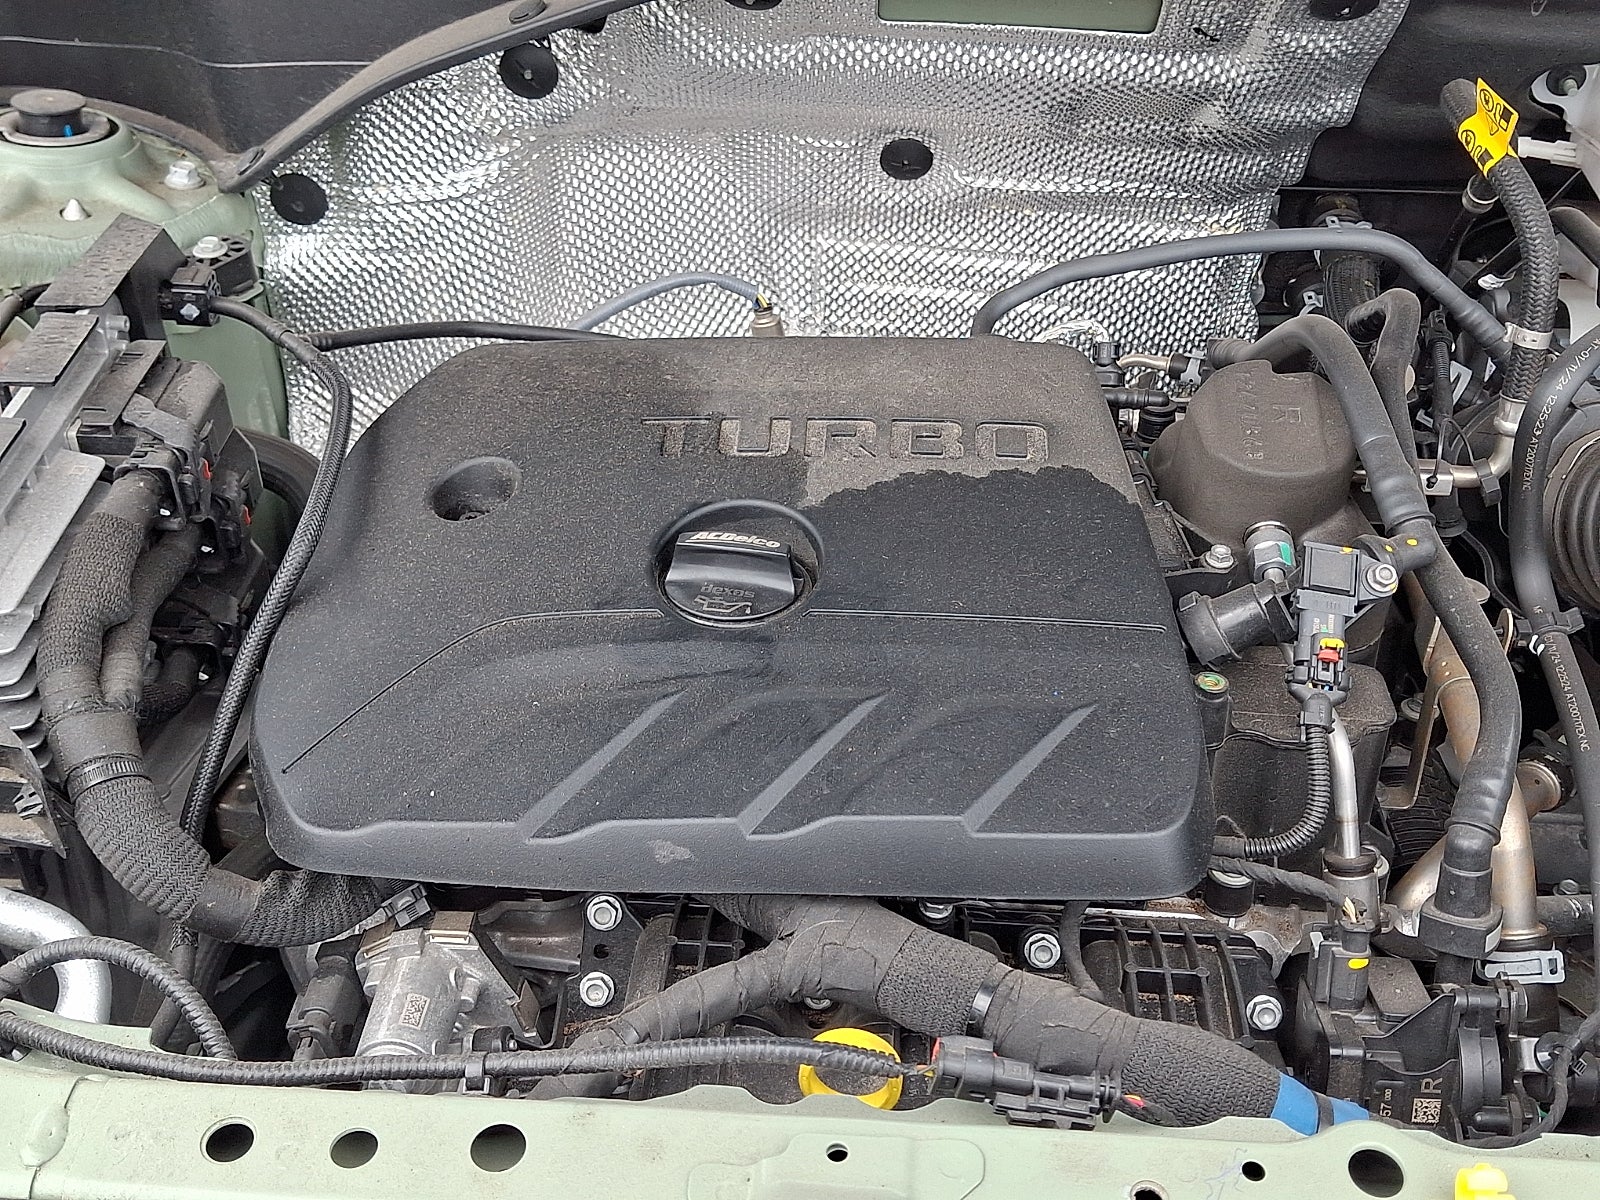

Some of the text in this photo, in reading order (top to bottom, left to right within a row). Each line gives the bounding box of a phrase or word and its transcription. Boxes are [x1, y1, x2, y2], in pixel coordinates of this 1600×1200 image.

[641, 416, 1050, 460] TURBO
[688, 531, 781, 548] ACDelco
[700, 583, 756, 599] dexos
[1420, 1077, 1443, 1094] R
